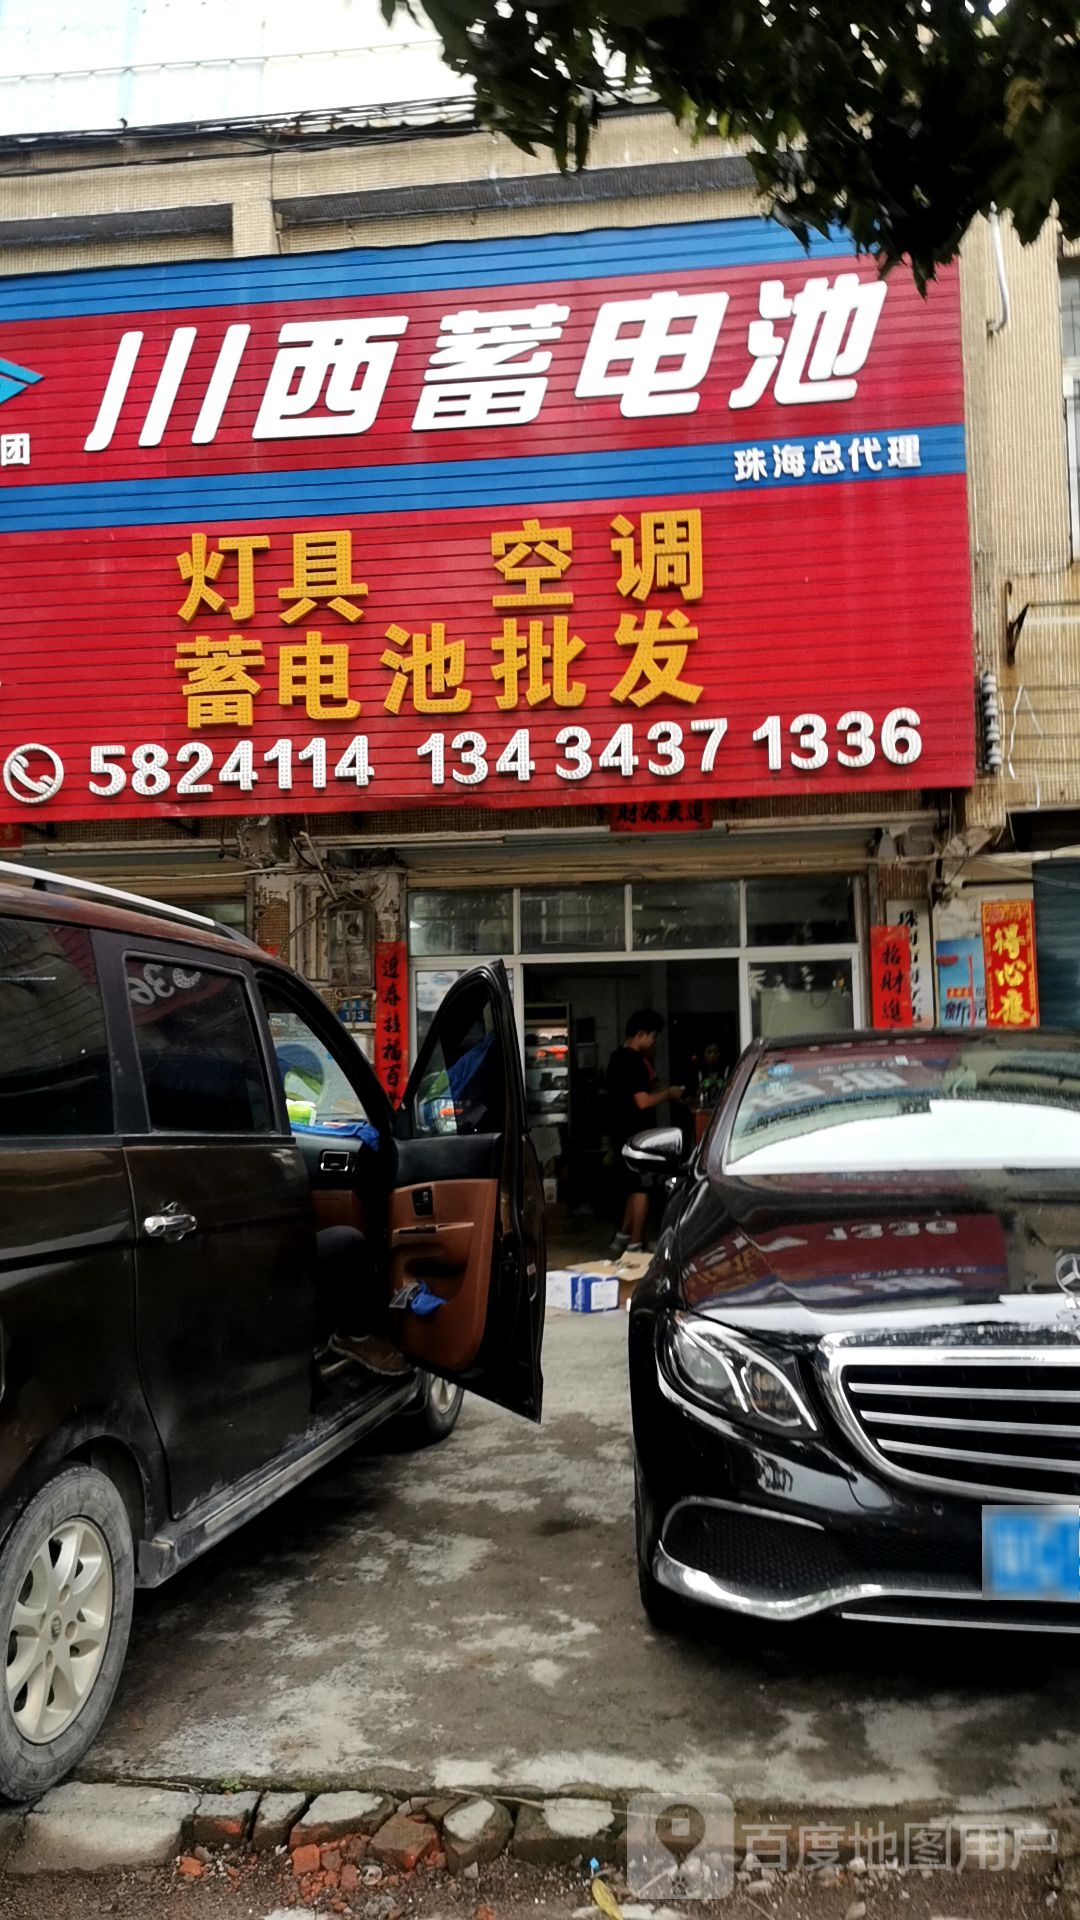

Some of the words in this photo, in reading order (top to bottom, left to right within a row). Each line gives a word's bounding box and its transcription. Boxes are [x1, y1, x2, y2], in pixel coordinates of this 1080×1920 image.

[84, 272, 888, 452] 川西蓄电池
[0, 433, 31, 467] 团
[733, 434, 921, 483] 珠海总代理
[176, 530, 369, 625] 灯具
[490, 508, 704, 608] 空调
[174, 608, 704, 729] 蓄电池批发
[89, 734, 375, 797] 5824114
[416, 729, 536, 785] 134
[555, 718, 729, 781] 3437
[752, 706, 923, 771] 1336
[876, 943, 905, 1028] 招財進
